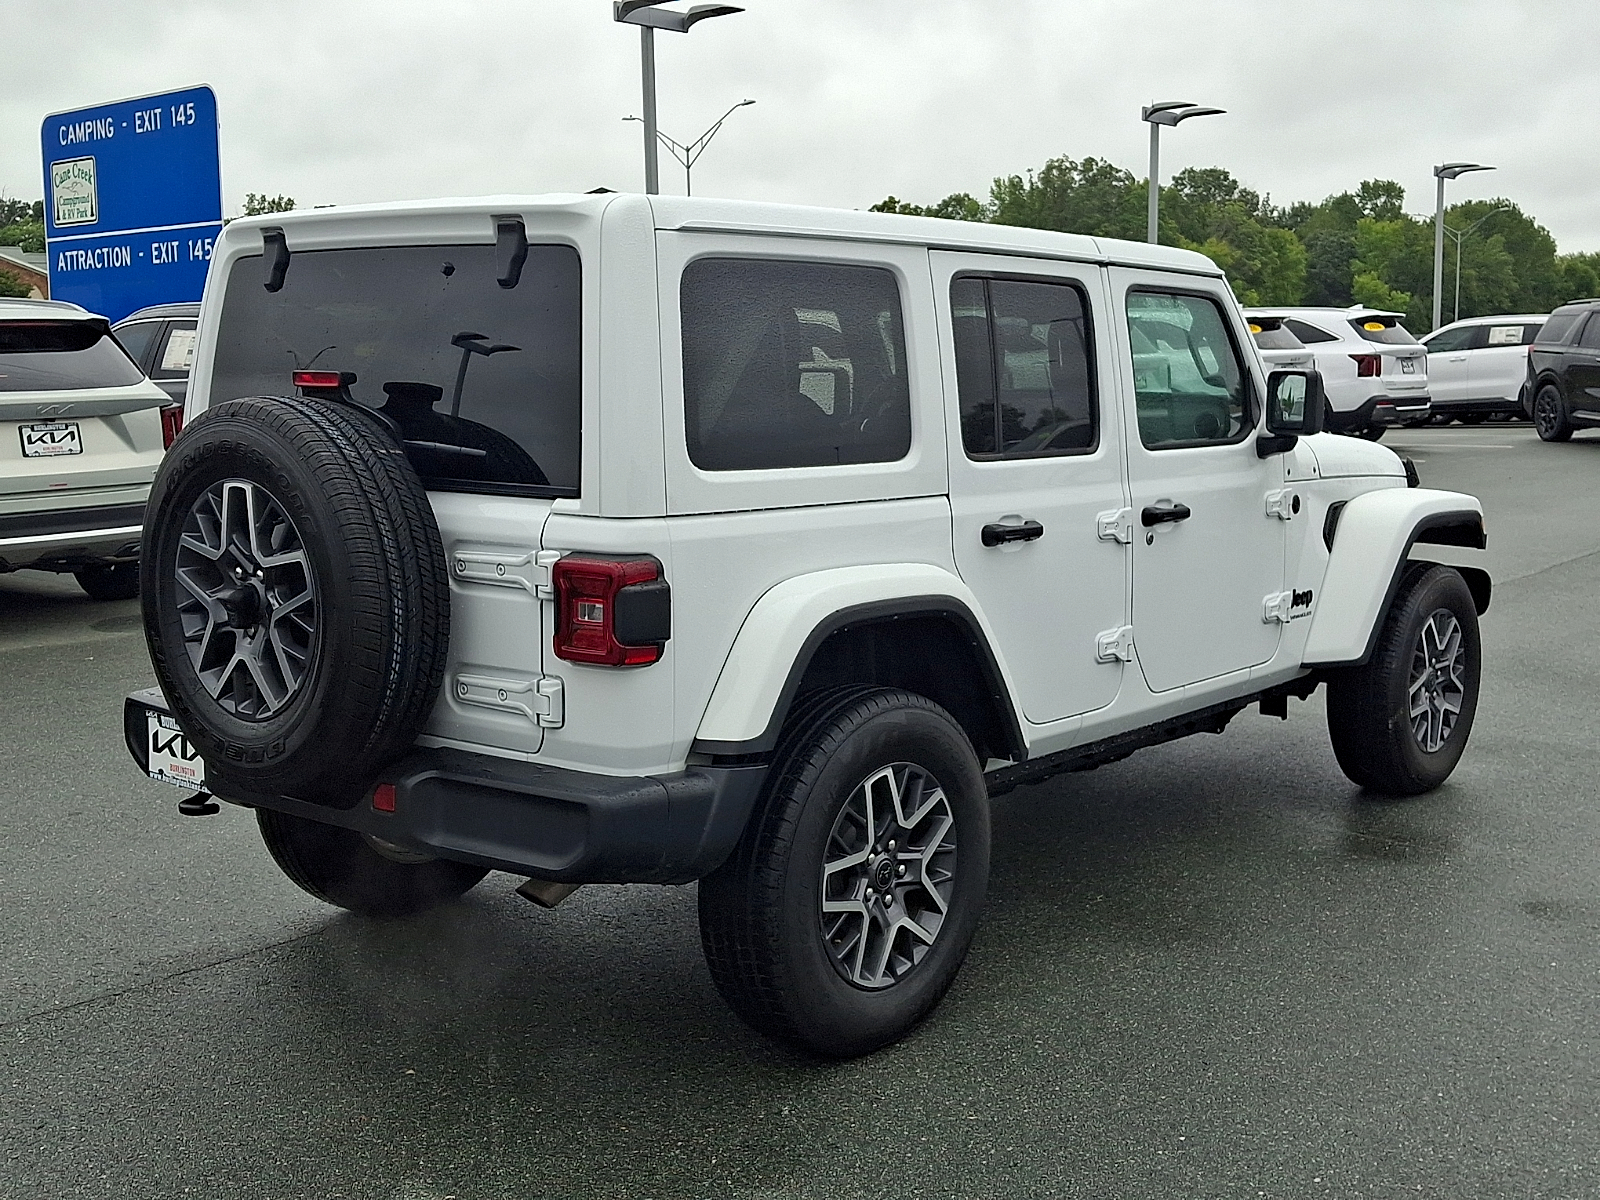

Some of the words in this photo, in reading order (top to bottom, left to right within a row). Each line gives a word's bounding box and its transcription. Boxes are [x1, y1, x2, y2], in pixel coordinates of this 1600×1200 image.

[59, 117, 115, 146] CAMPING
[134, 108, 162, 134] EXIT
[170, 102, 196, 128] 145
[54, 166, 71, 188] Cane
[72, 163, 93, 186] Creek
[58, 194, 90, 207] Campground
[67, 208, 76, 219] RV
[76, 207, 88, 218] Park
[57, 246, 131, 272] ATTRACTION
[151, 240, 179, 265] EXIT
[188, 238, 212, 262] 145
[1290, 589, 1314, 609] Jeep
[169, 763, 197, 778] BURLINGTON
